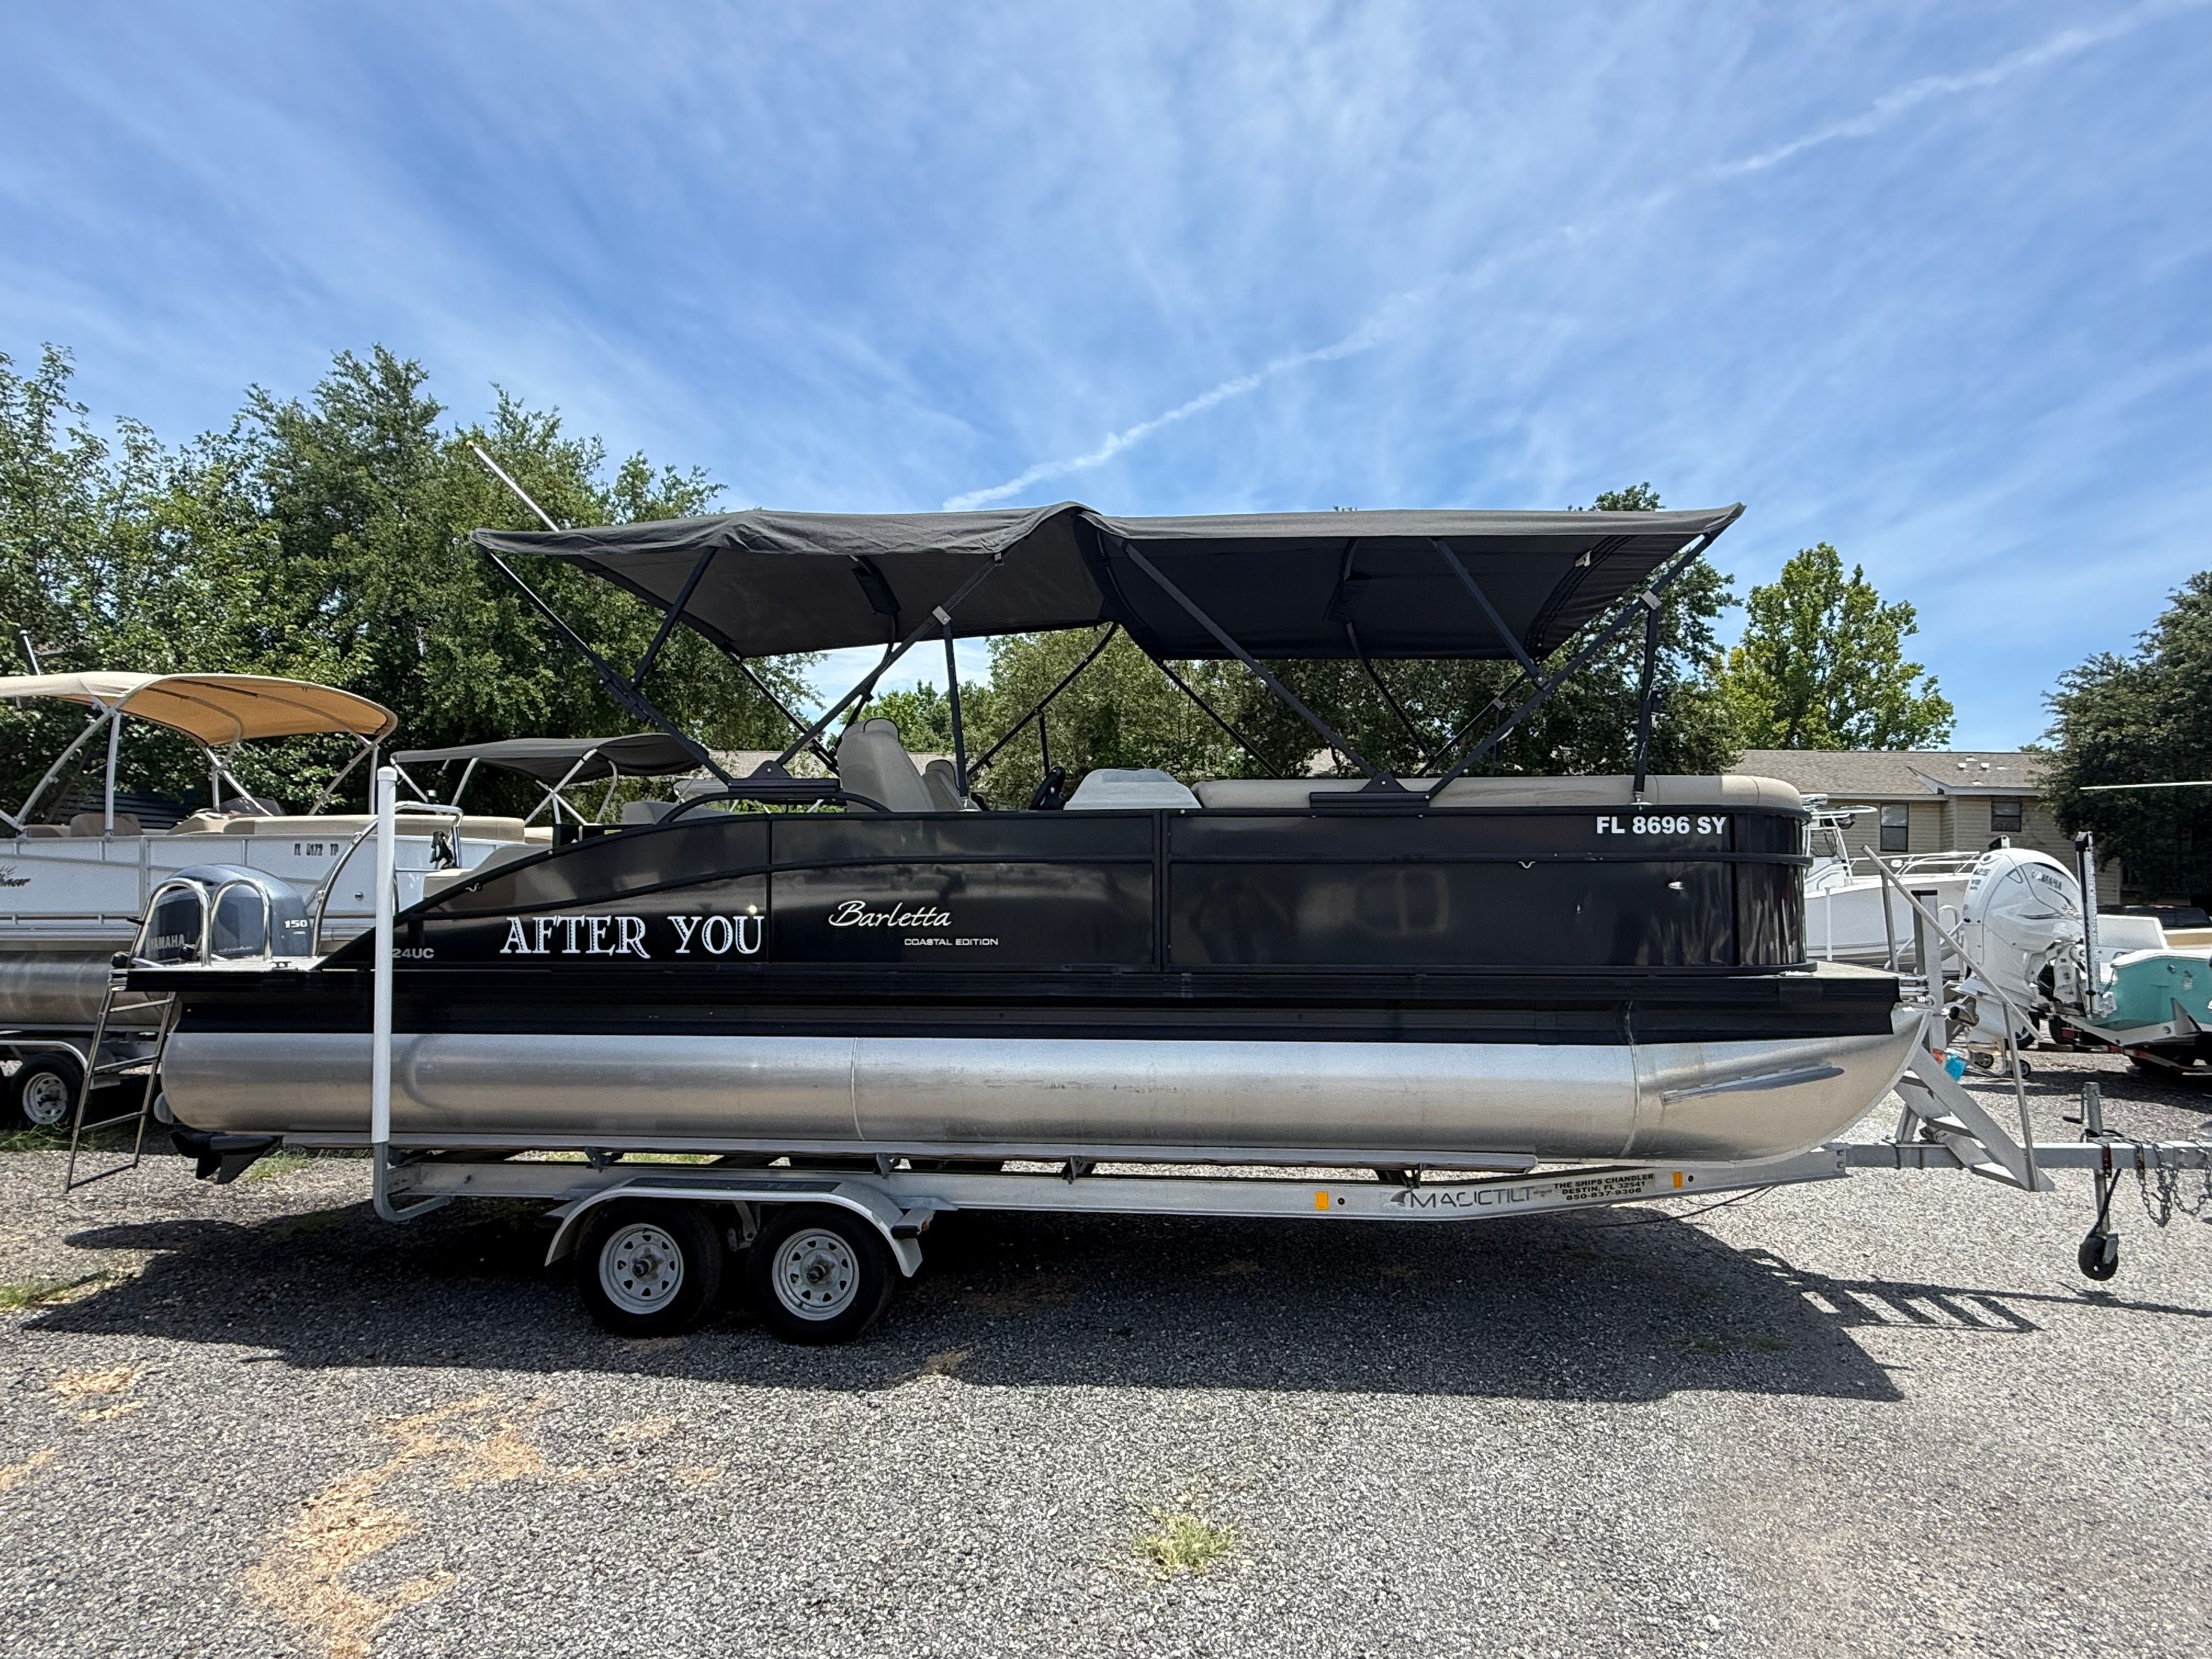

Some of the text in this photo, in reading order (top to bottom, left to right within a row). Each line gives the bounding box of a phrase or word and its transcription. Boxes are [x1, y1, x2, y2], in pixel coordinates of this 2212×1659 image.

[1596, 816, 1726, 834] FL 8696 SY
[828, 900, 952, 927] Barletta
[284, 919, 308, 928] 150
[500, 915, 765, 959] AFTER YOU
[392, 948, 435, 958] 24UC
[1575, 1178, 1602, 1187] SHIPS
[1605, 1173, 1654, 1184] CHANDLER
